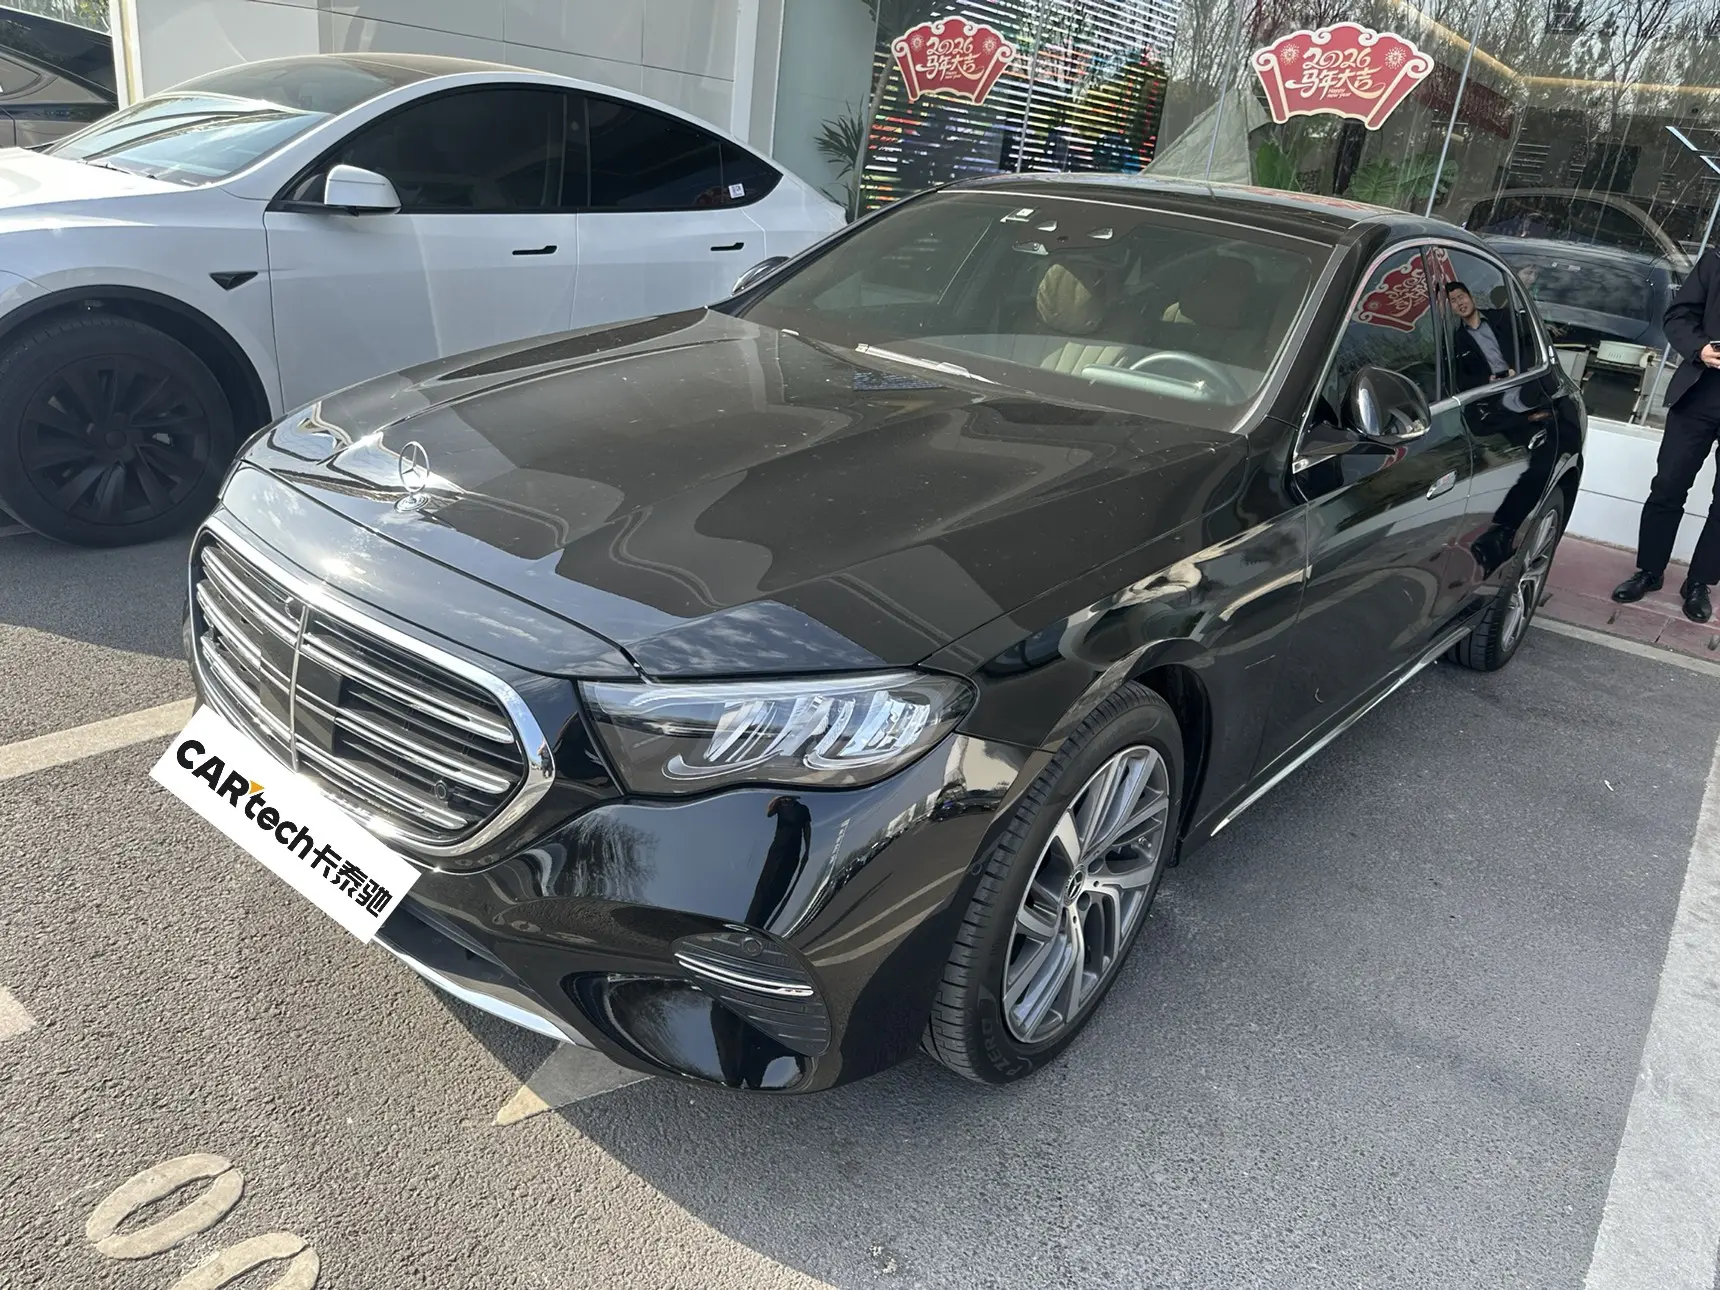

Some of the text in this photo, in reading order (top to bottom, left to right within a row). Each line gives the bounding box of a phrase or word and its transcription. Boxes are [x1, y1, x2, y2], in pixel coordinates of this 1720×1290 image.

[926, 36, 974, 56] 2026
[1302, 46, 1372, 70] 2026
[915, 52, 985, 81] 马年大吉
[1284, 65, 1387, 101] 马年大吉
